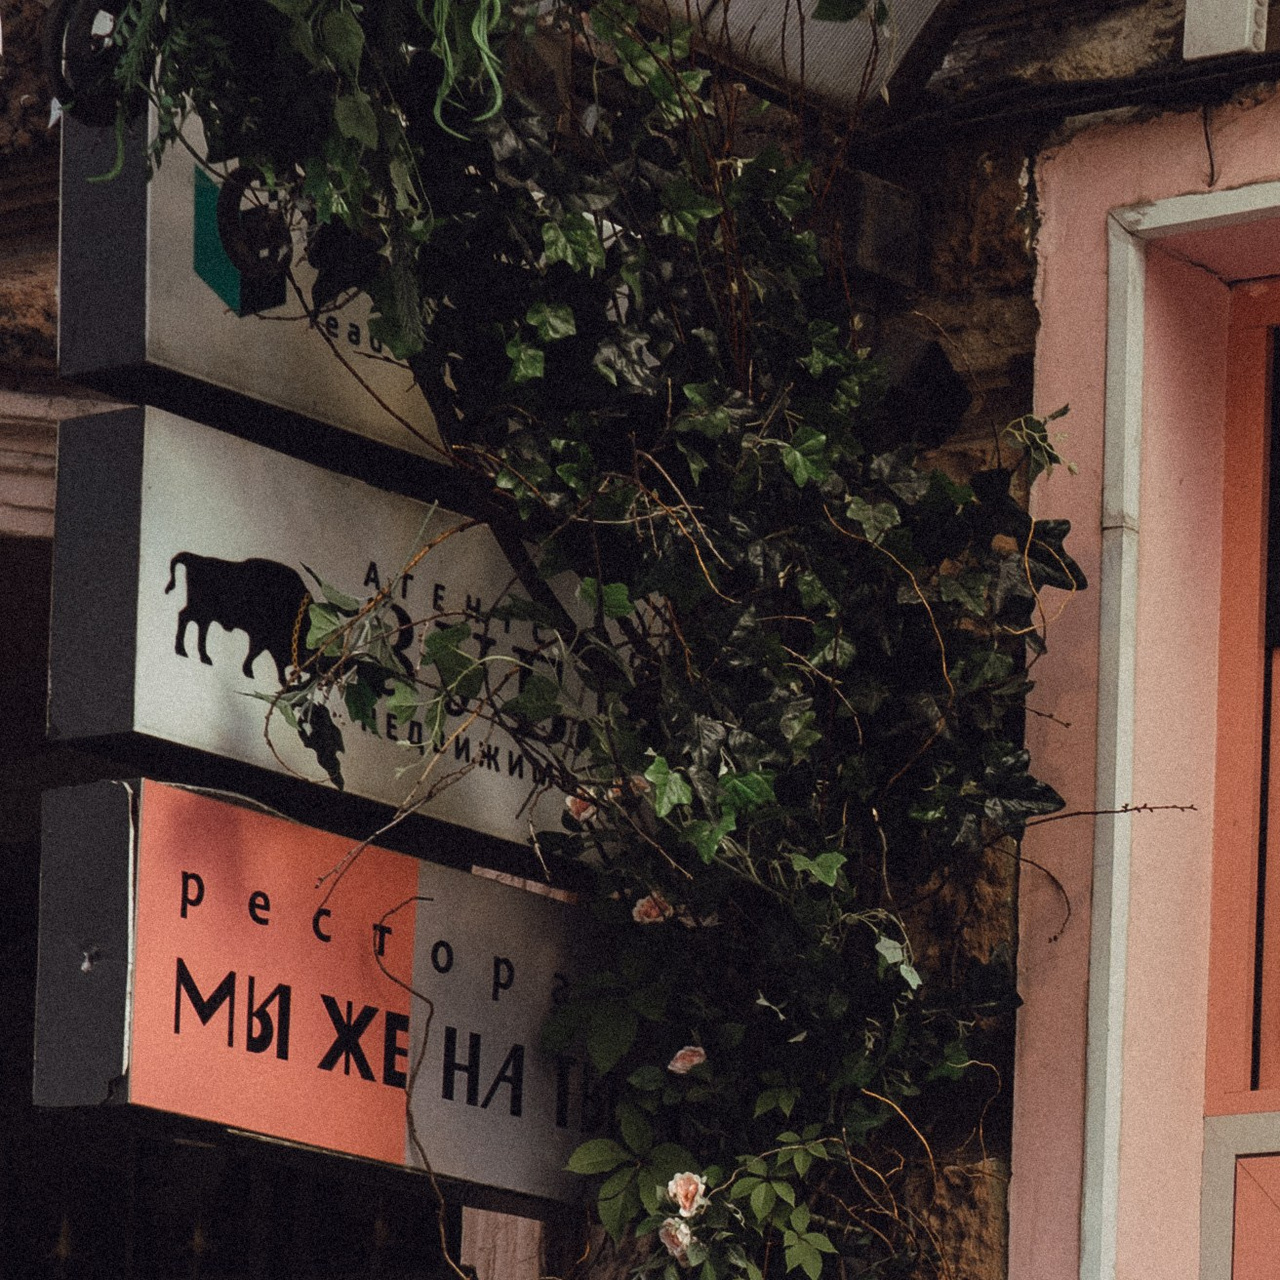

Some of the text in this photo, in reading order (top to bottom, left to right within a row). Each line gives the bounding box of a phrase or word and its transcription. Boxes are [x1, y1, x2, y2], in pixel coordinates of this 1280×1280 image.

[174, 957, 292, 1062] МЫ
[317, 993, 411, 1090] ЖЕ
[441, 1025, 525, 1118] НА
